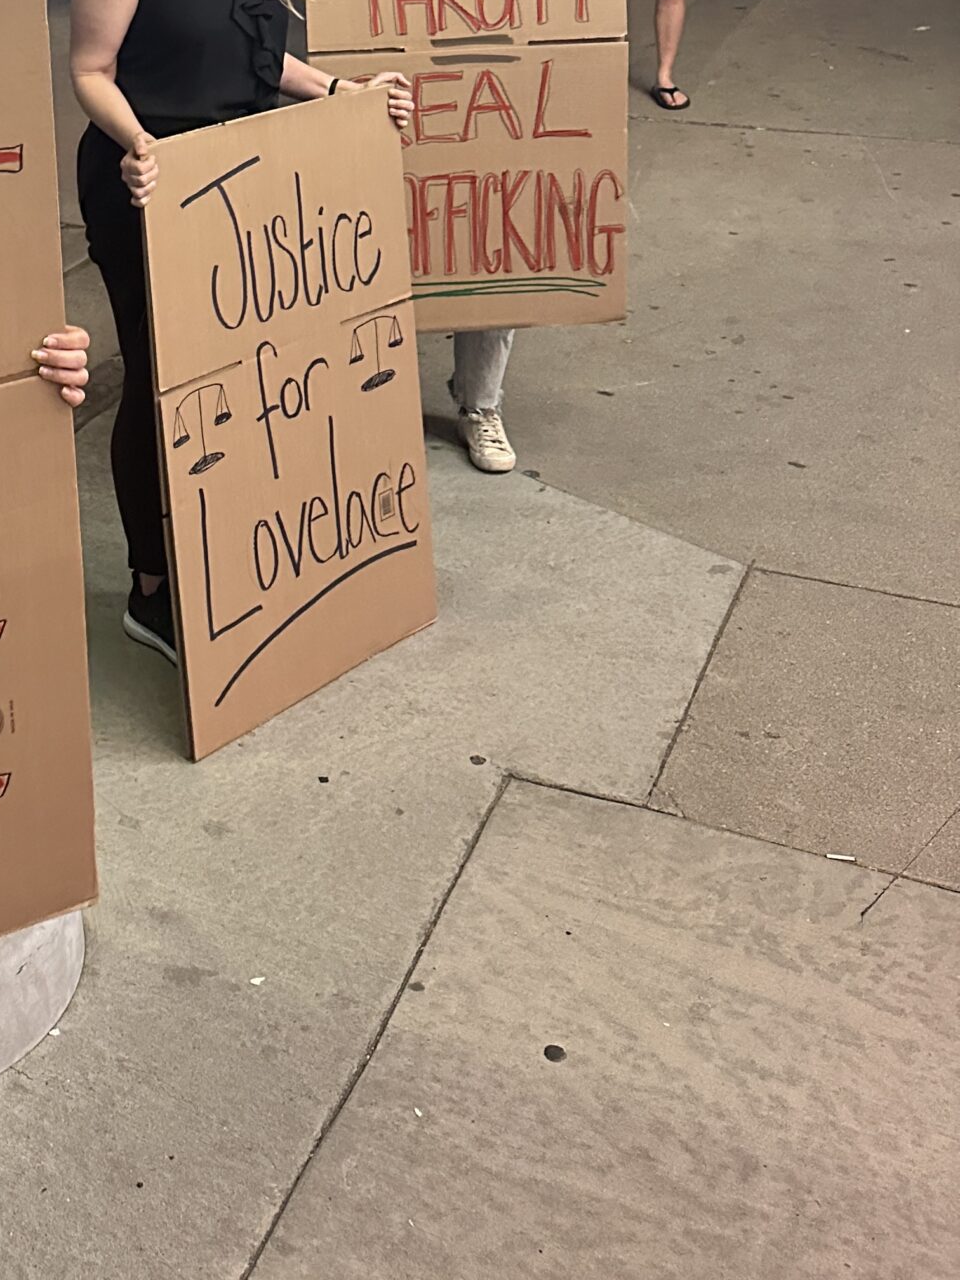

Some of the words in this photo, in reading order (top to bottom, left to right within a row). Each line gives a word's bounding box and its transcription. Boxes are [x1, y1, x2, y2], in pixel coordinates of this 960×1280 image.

[348, 60, 592, 149] EAL
[180, 156, 381, 330] Justice
[257, 340, 328, 479] for
[197, 416, 419, 642] Lovelace
